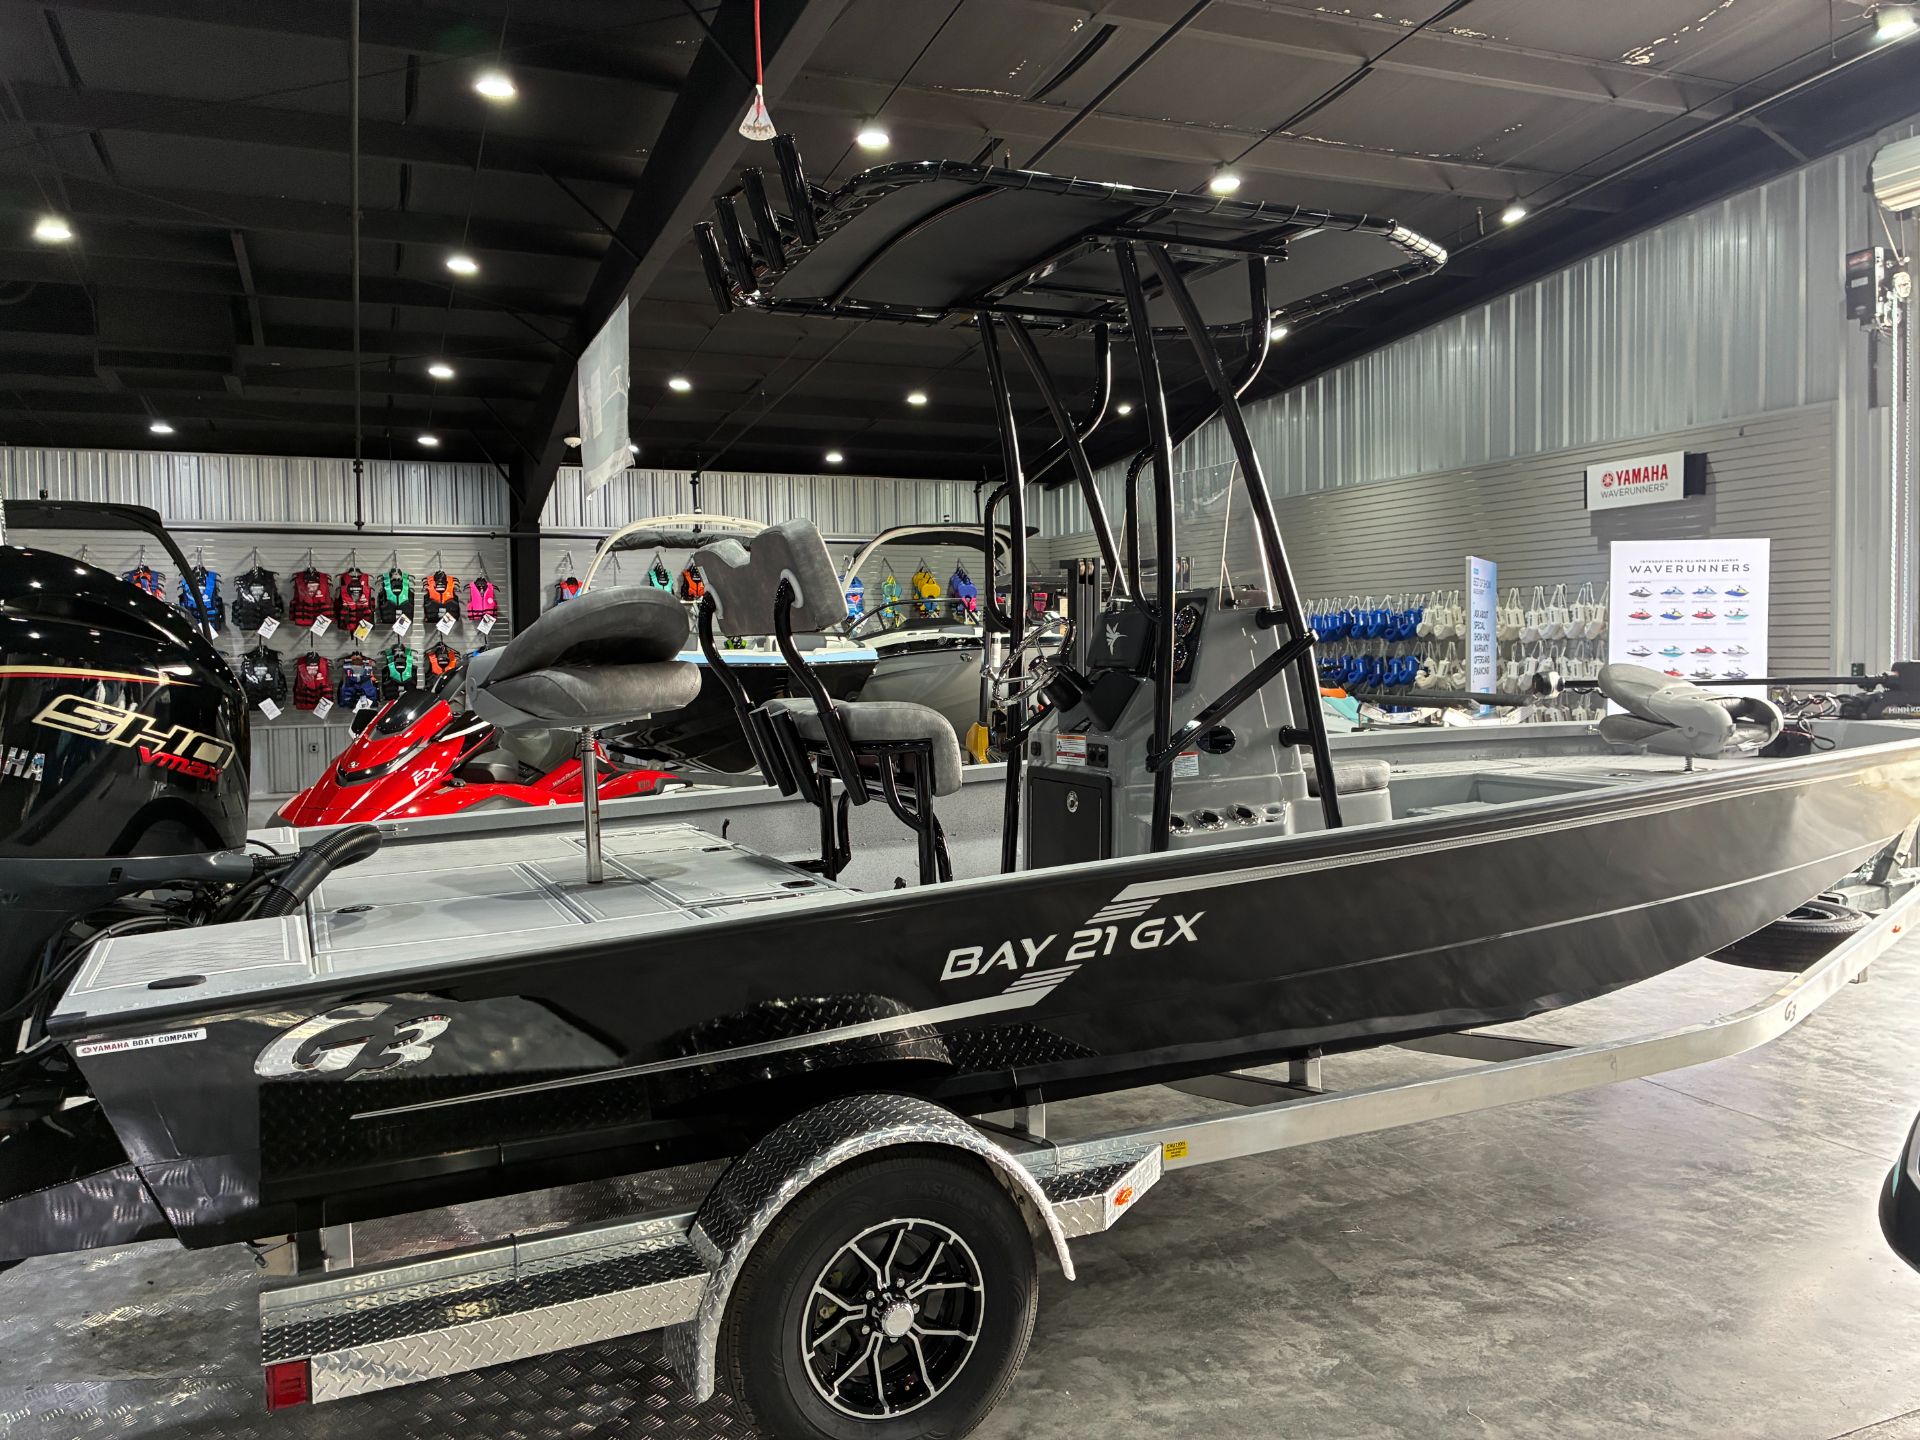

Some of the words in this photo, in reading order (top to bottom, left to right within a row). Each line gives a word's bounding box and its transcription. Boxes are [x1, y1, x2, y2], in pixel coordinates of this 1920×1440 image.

[1616, 464, 1668, 486] YAMAHA
[1629, 563, 1750, 574] WAVERUNNERS
[32, 694, 235, 769] SHO
[0, 744, 46, 782] HA
[411, 761, 439, 787] FX
[940, 934, 1058, 982] BAY
[1065, 925, 1118, 962] 21
[1130, 911, 1207, 950] GX
[93, 1042, 129, 1053] YAMAHA
[132, 1039, 155, 1047] BOAT
[158, 1031, 199, 1043] COMPANY
[253, 1001, 451, 1081] G3
